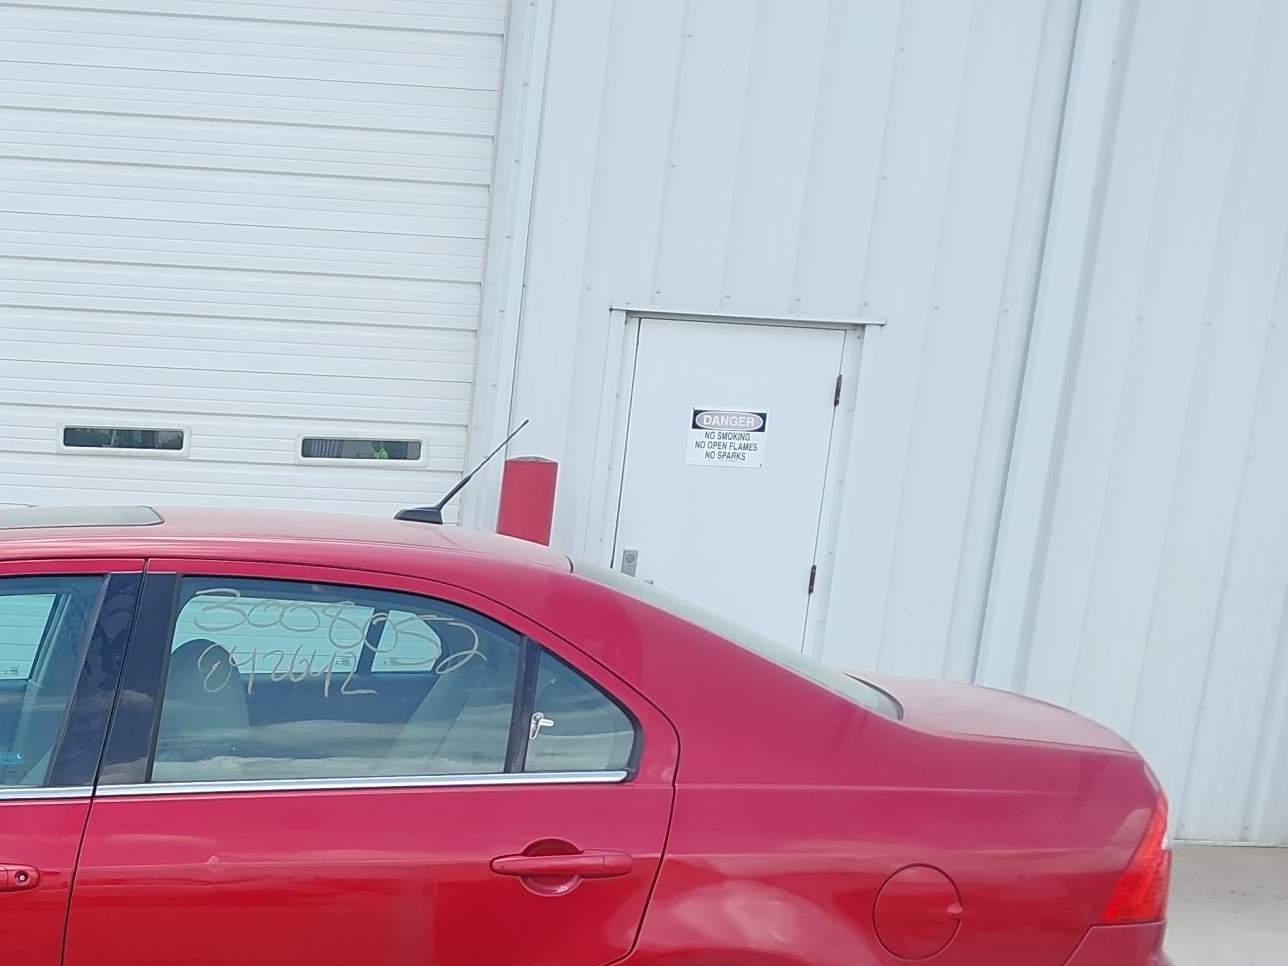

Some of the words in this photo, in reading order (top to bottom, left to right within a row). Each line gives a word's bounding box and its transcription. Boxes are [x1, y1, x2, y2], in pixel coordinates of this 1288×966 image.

[703, 415, 754, 427] DANGER
[704, 431, 715, 440] NO
[717, 432, 751, 441] SMOKING
[695, 440, 706, 449] NO
[707, 441, 727, 450] OPEN
[729, 443, 758, 451] FLAMES
[705, 450, 715, 459] NO
[717, 451, 746, 460] SPARKS
